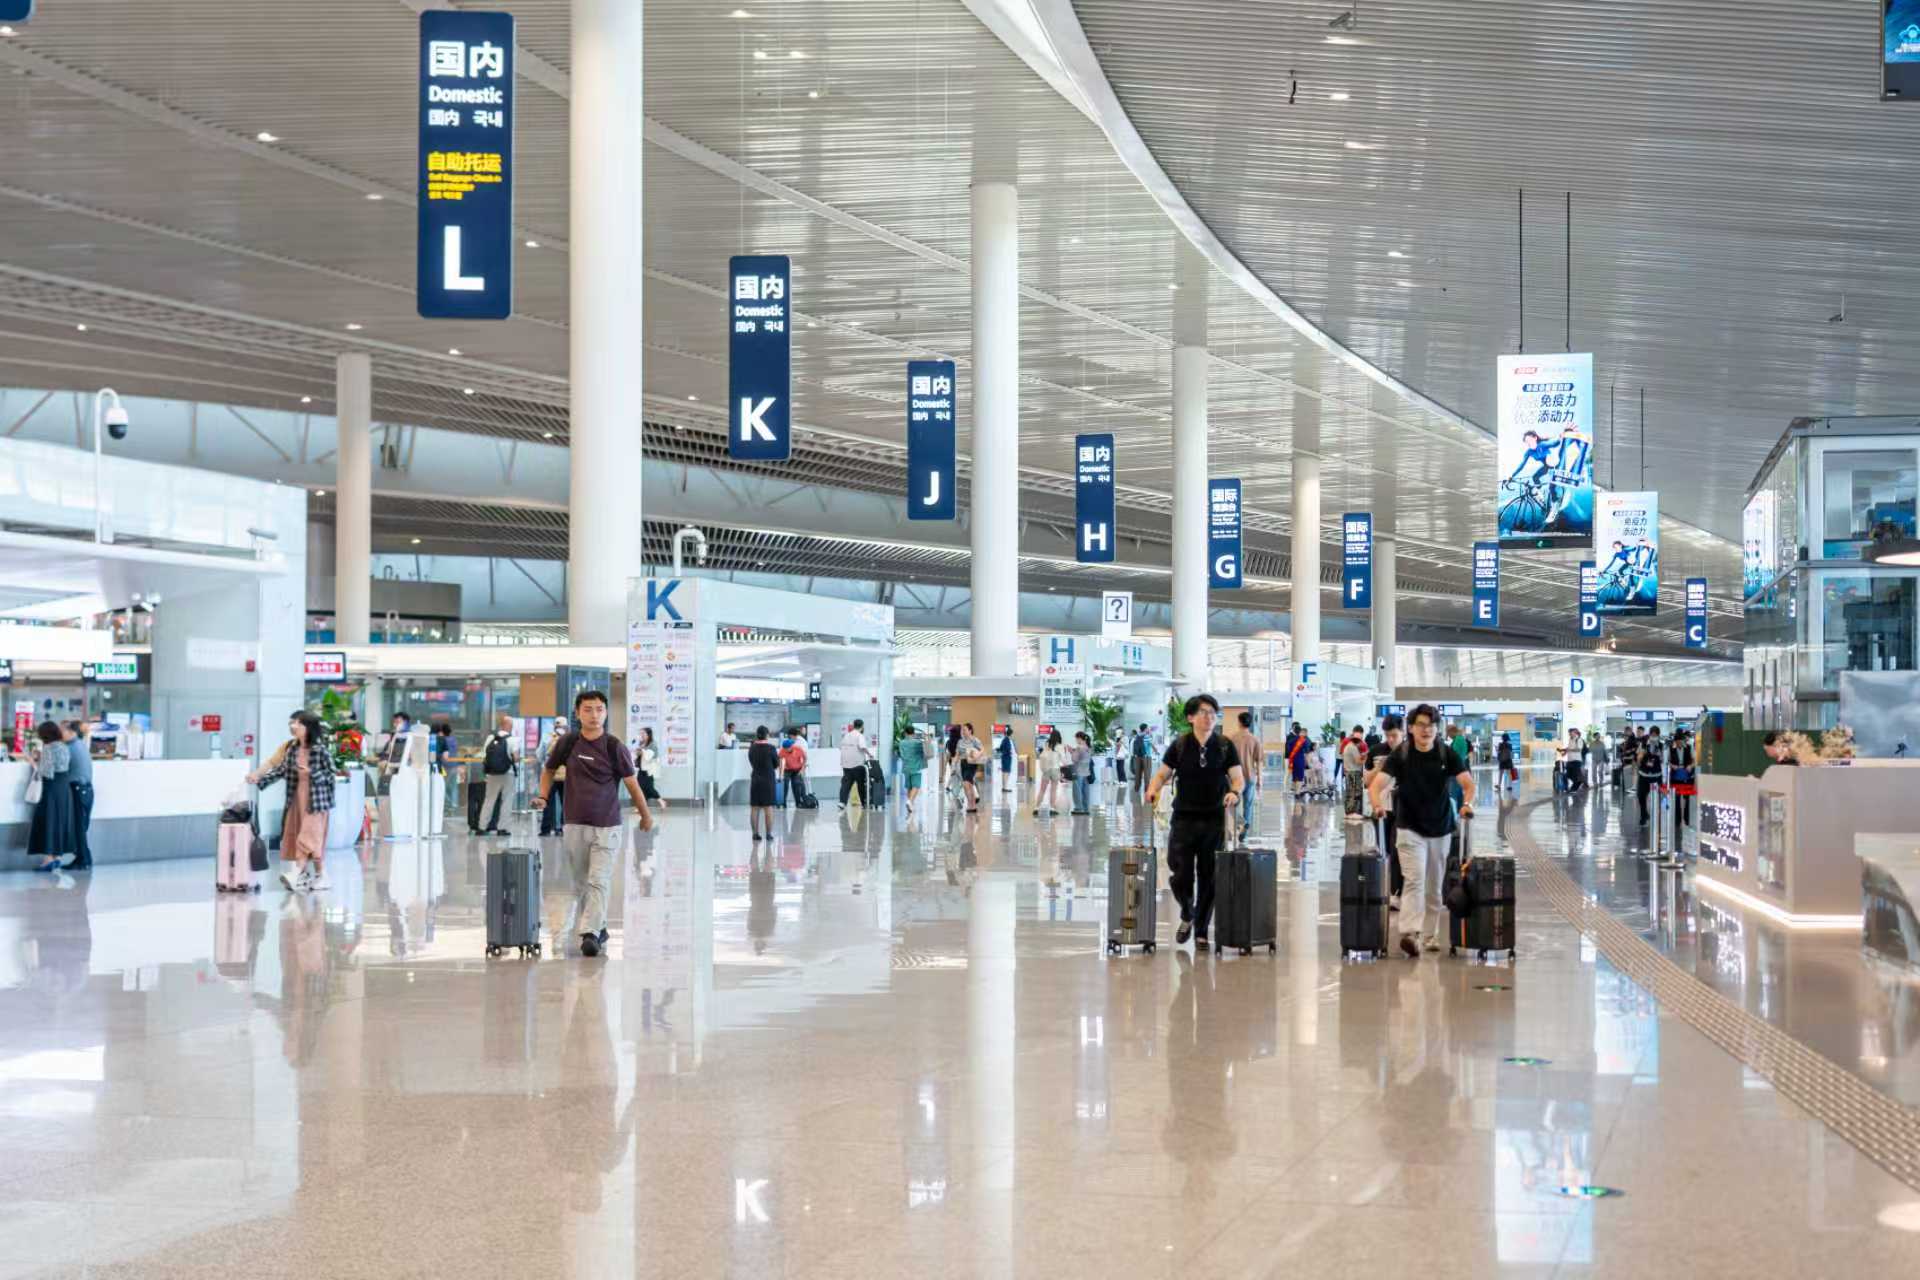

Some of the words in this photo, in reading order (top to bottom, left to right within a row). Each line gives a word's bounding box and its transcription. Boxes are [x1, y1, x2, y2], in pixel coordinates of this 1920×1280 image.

[429, 41, 504, 78] 国内
[429, 86, 503, 104] Domestic
[428, 110, 460, 127] 国内
[473, 111, 503, 128] 국내
[428, 152, 502, 173] 自助托运
[444, 226, 485, 290] L
[735, 275, 784, 300] 国内
[735, 305, 784, 317] Domestic
[912, 376, 951, 395] 国内
[912, 399, 951, 409] Domestic
[741, 397, 777, 441] K
[1079, 446, 1110, 462] 国内
[923, 471, 940, 506] J
[1084, 523, 1107, 551] H
[1215, 554, 1236, 579] G
[1351, 579, 1364, 600] F
[648, 580, 683, 620] K
[1480, 600, 1492, 618] E
[1582, 613, 1598, 630] D
[1689, 625, 1703, 641] C
[1051, 638, 1075, 664] H
[1302, 663, 1317, 683] F
[1570, 678, 1585, 694] D
